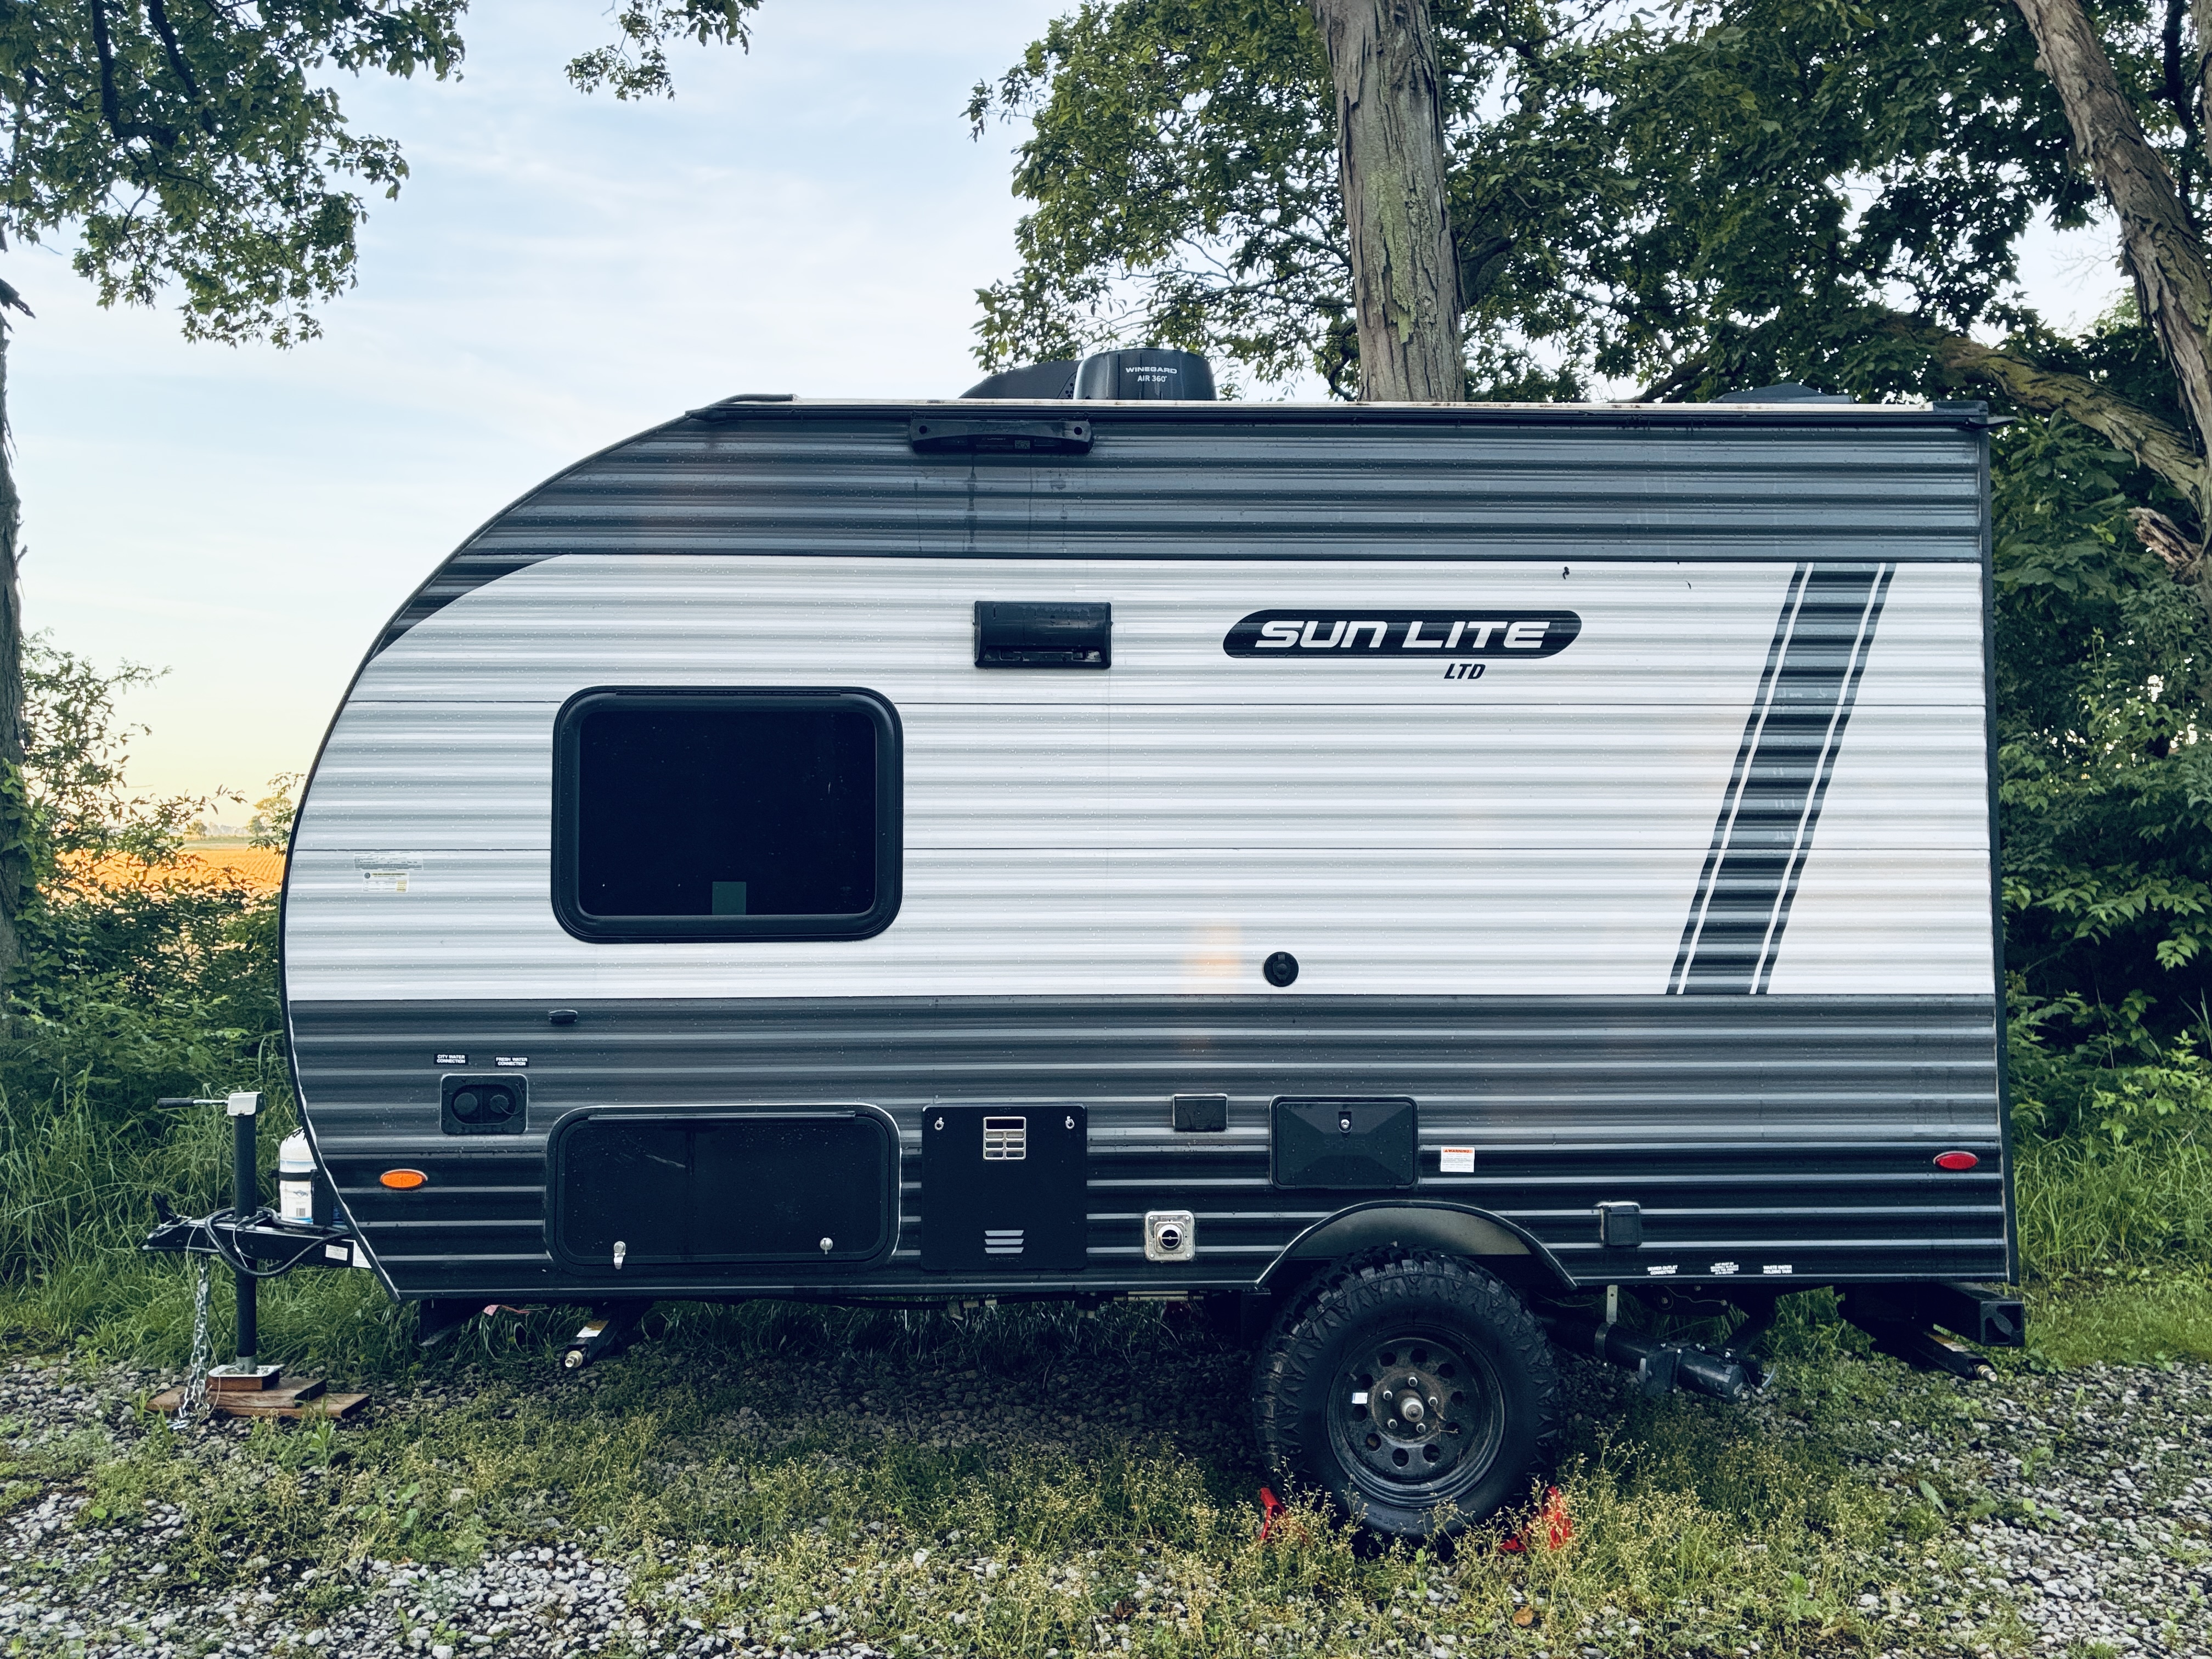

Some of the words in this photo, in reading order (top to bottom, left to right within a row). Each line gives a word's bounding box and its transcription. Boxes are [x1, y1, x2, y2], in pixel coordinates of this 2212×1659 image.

[1255, 620, 1388, 648] SUN
[1402, 620, 1550, 648] LITE
[1444, 663, 1486, 679] LTD
[1324, 1139, 1365, 1149] SHOWER
